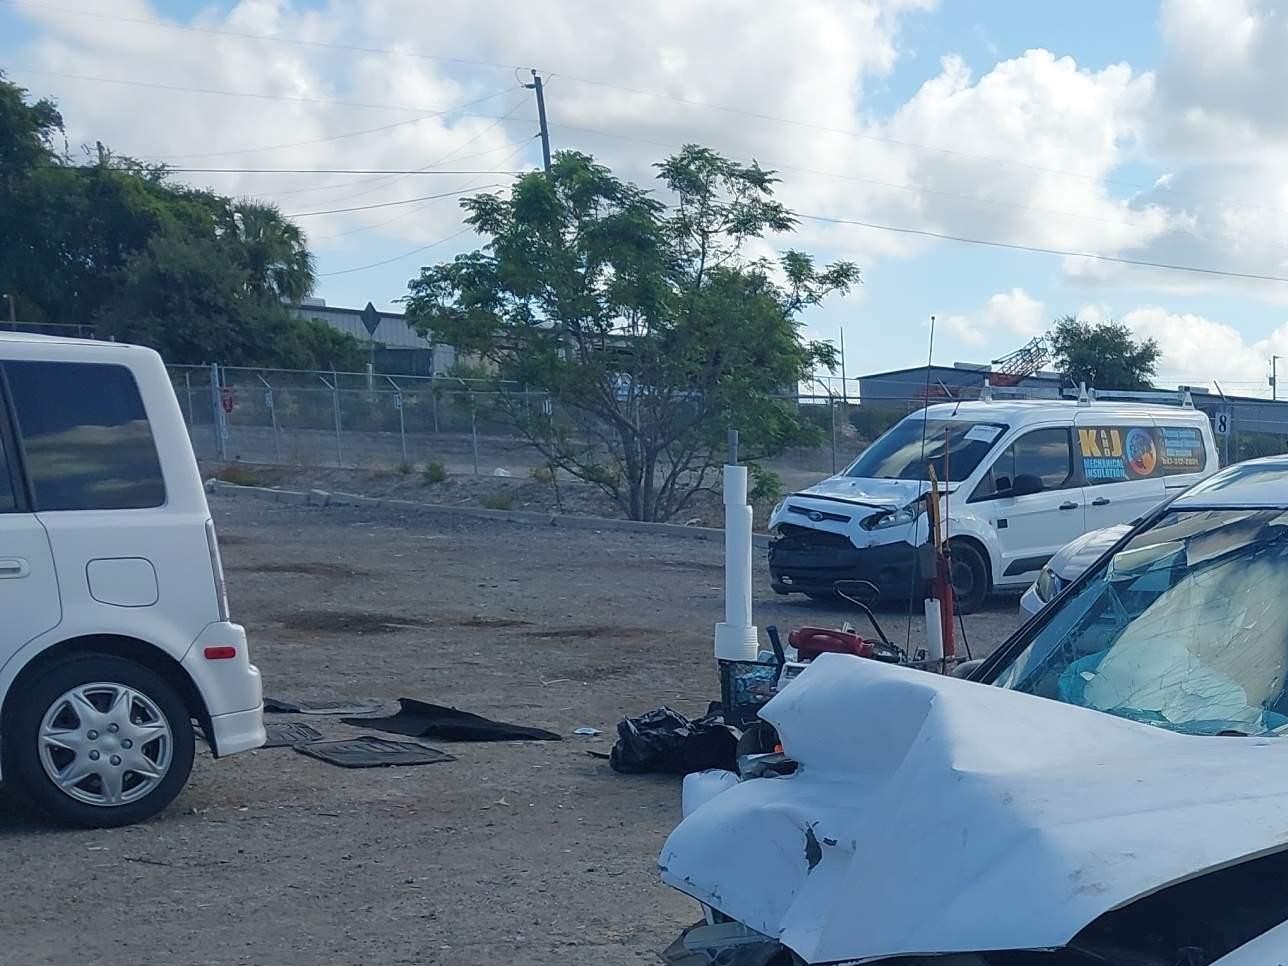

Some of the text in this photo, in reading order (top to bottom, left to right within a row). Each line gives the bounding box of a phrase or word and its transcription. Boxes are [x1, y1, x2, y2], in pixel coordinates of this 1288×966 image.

[1219, 415, 1227, 433] 8
[1079, 429, 1102, 456] K
[1110, 430, 1122, 456] J
[1083, 458, 1124, 469] MECHANICAL
[1085, 468, 1125, 479] INSULATION
